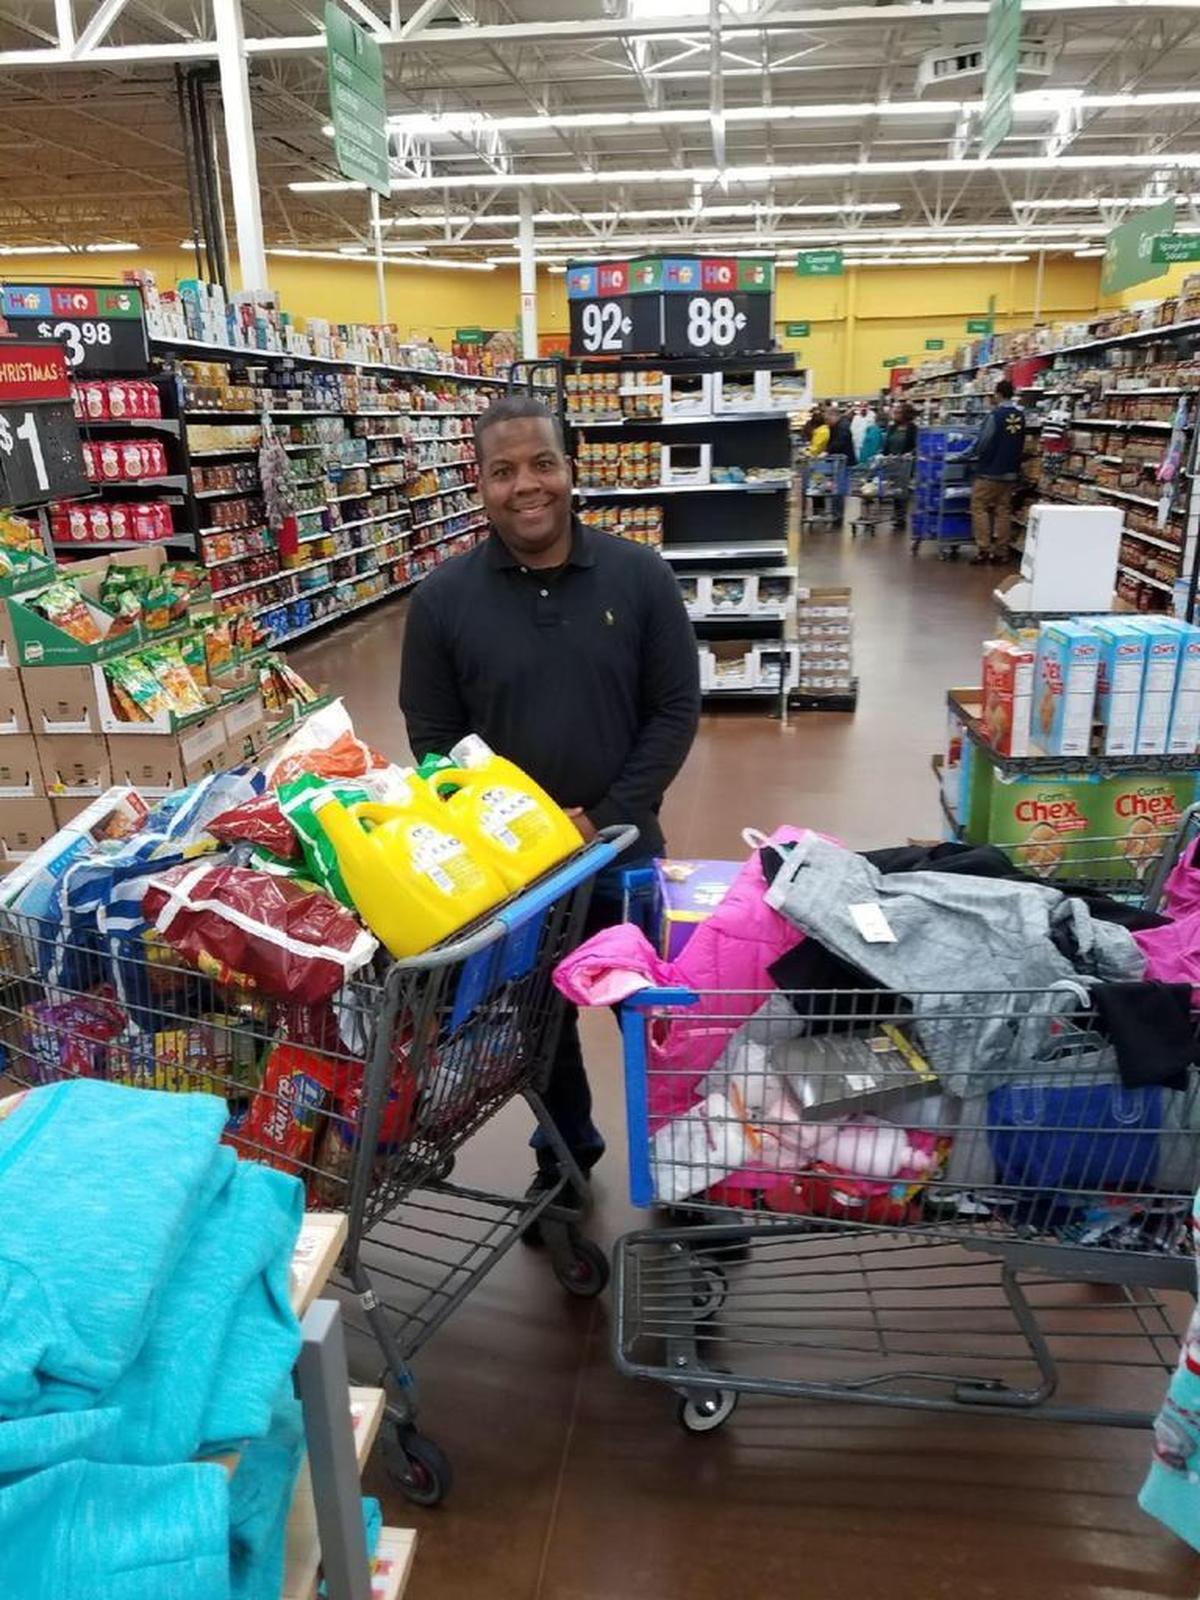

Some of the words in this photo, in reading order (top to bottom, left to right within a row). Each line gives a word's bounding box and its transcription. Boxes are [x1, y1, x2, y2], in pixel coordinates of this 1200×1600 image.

[0, 362, 58, 382] HRISTMAS
[1015, 801, 1078, 824] Chex
[1115, 794, 1175, 817] Chex
